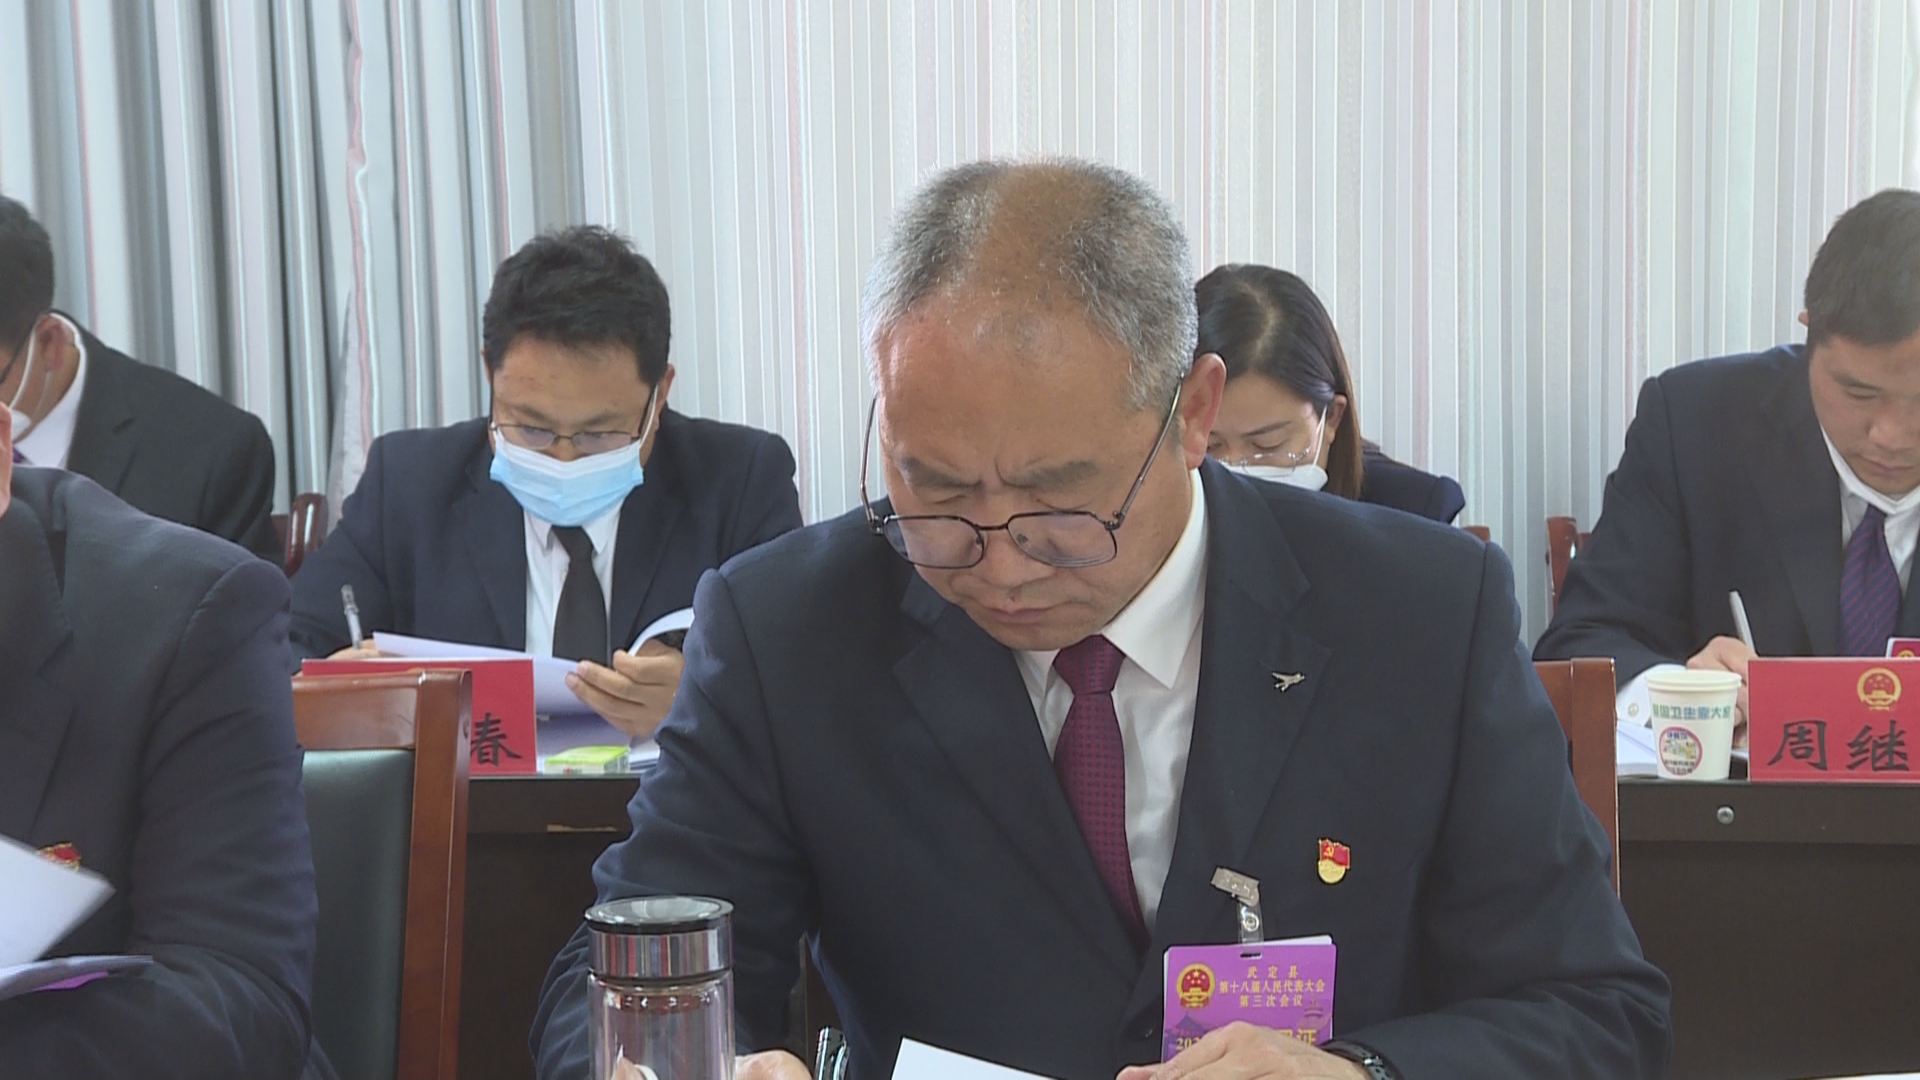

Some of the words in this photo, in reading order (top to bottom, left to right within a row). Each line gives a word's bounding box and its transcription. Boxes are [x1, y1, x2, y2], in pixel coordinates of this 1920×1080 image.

[470, 712, 522, 767] 春
[1767, 719, 1909, 771] 周继
[1219, 979, 1326, 995] 第十八届人民代表大会
[1239, 994, 1303, 1009] 第三次会议
